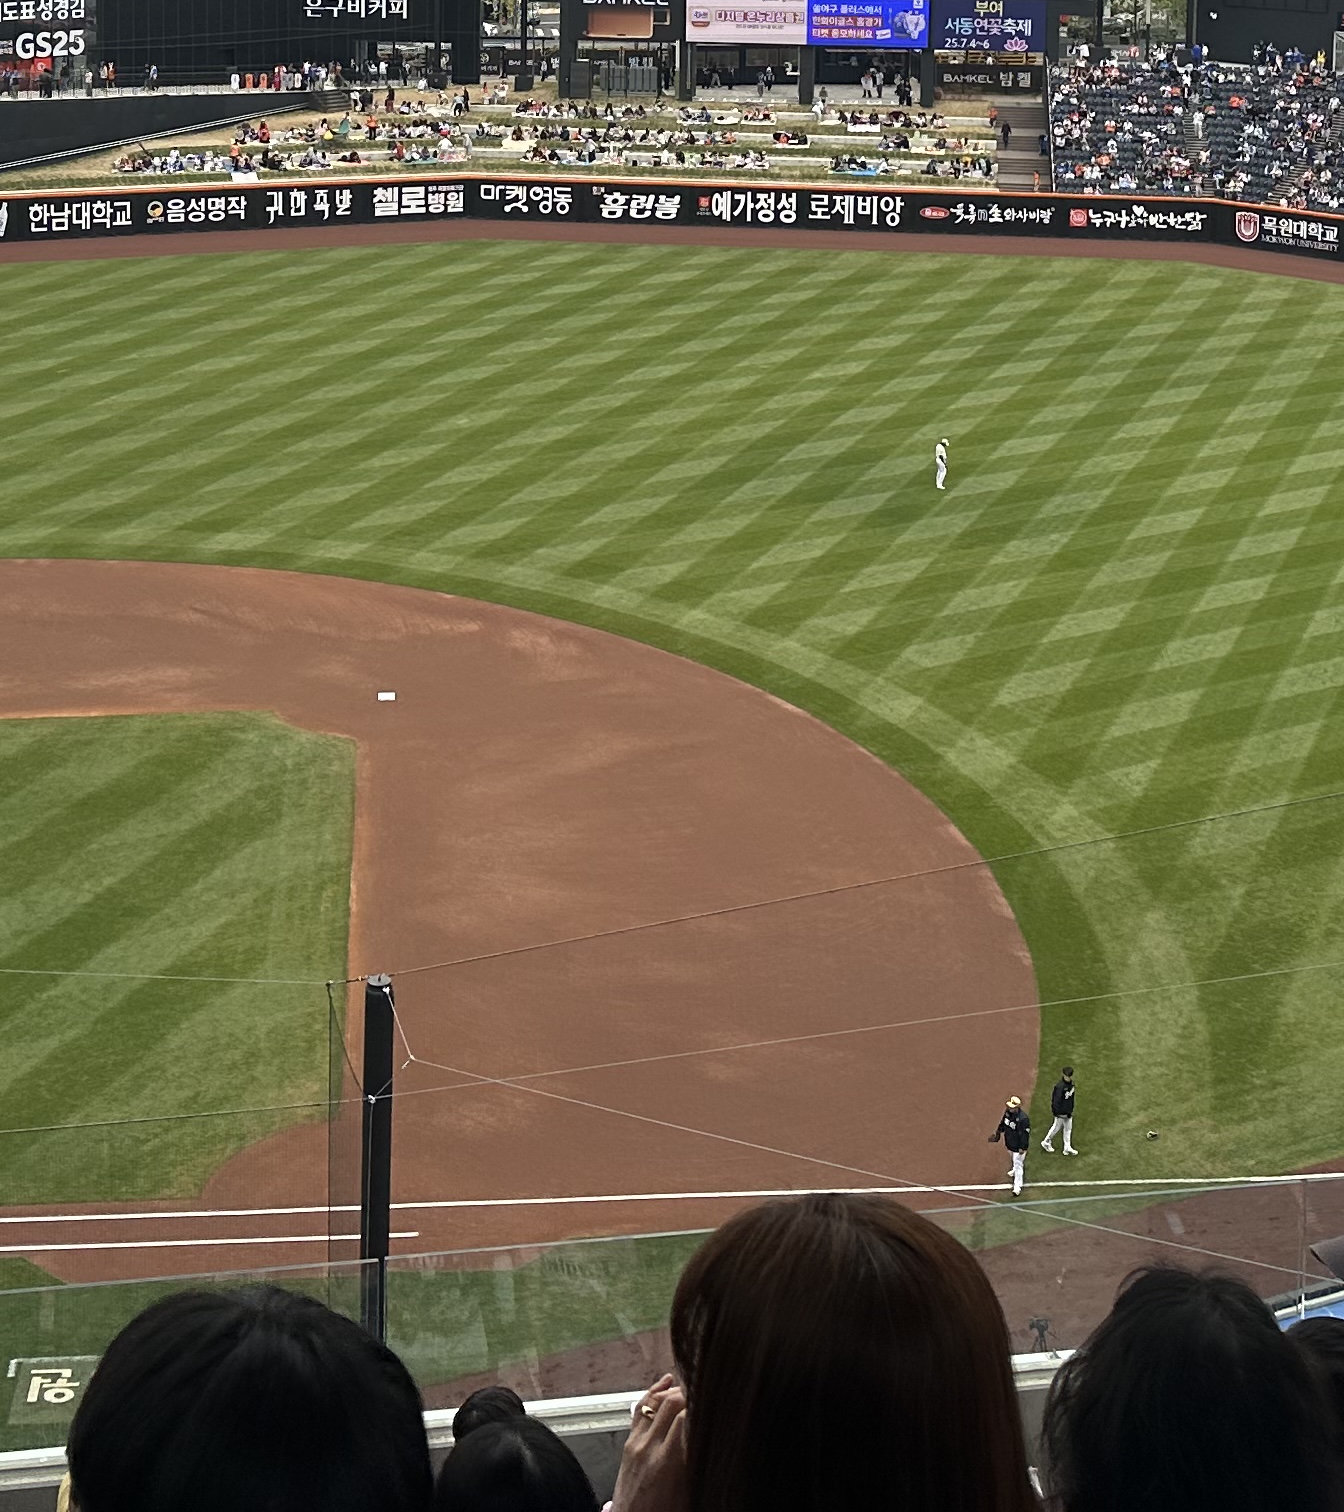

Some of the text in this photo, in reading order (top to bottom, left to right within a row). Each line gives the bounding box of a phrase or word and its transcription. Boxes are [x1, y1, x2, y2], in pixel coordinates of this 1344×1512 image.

[974, 0, 1003, 17] 부여
[945, 18, 1032, 36] 서동연꽃축제
[15, 29, 85, 59] GS25
[944, 38, 990, 48] 25.7.4~6
[166, 195, 248, 223] 음성명작
[480, 184, 573, 215] 마켓영동
[599, 191, 681, 220] 홈런볼
[712, 190, 905, 227] 예가정성 로제비앙
[29, 200, 132, 232] 한남대학교
[1261, 216, 1339, 243] 목원대학교
